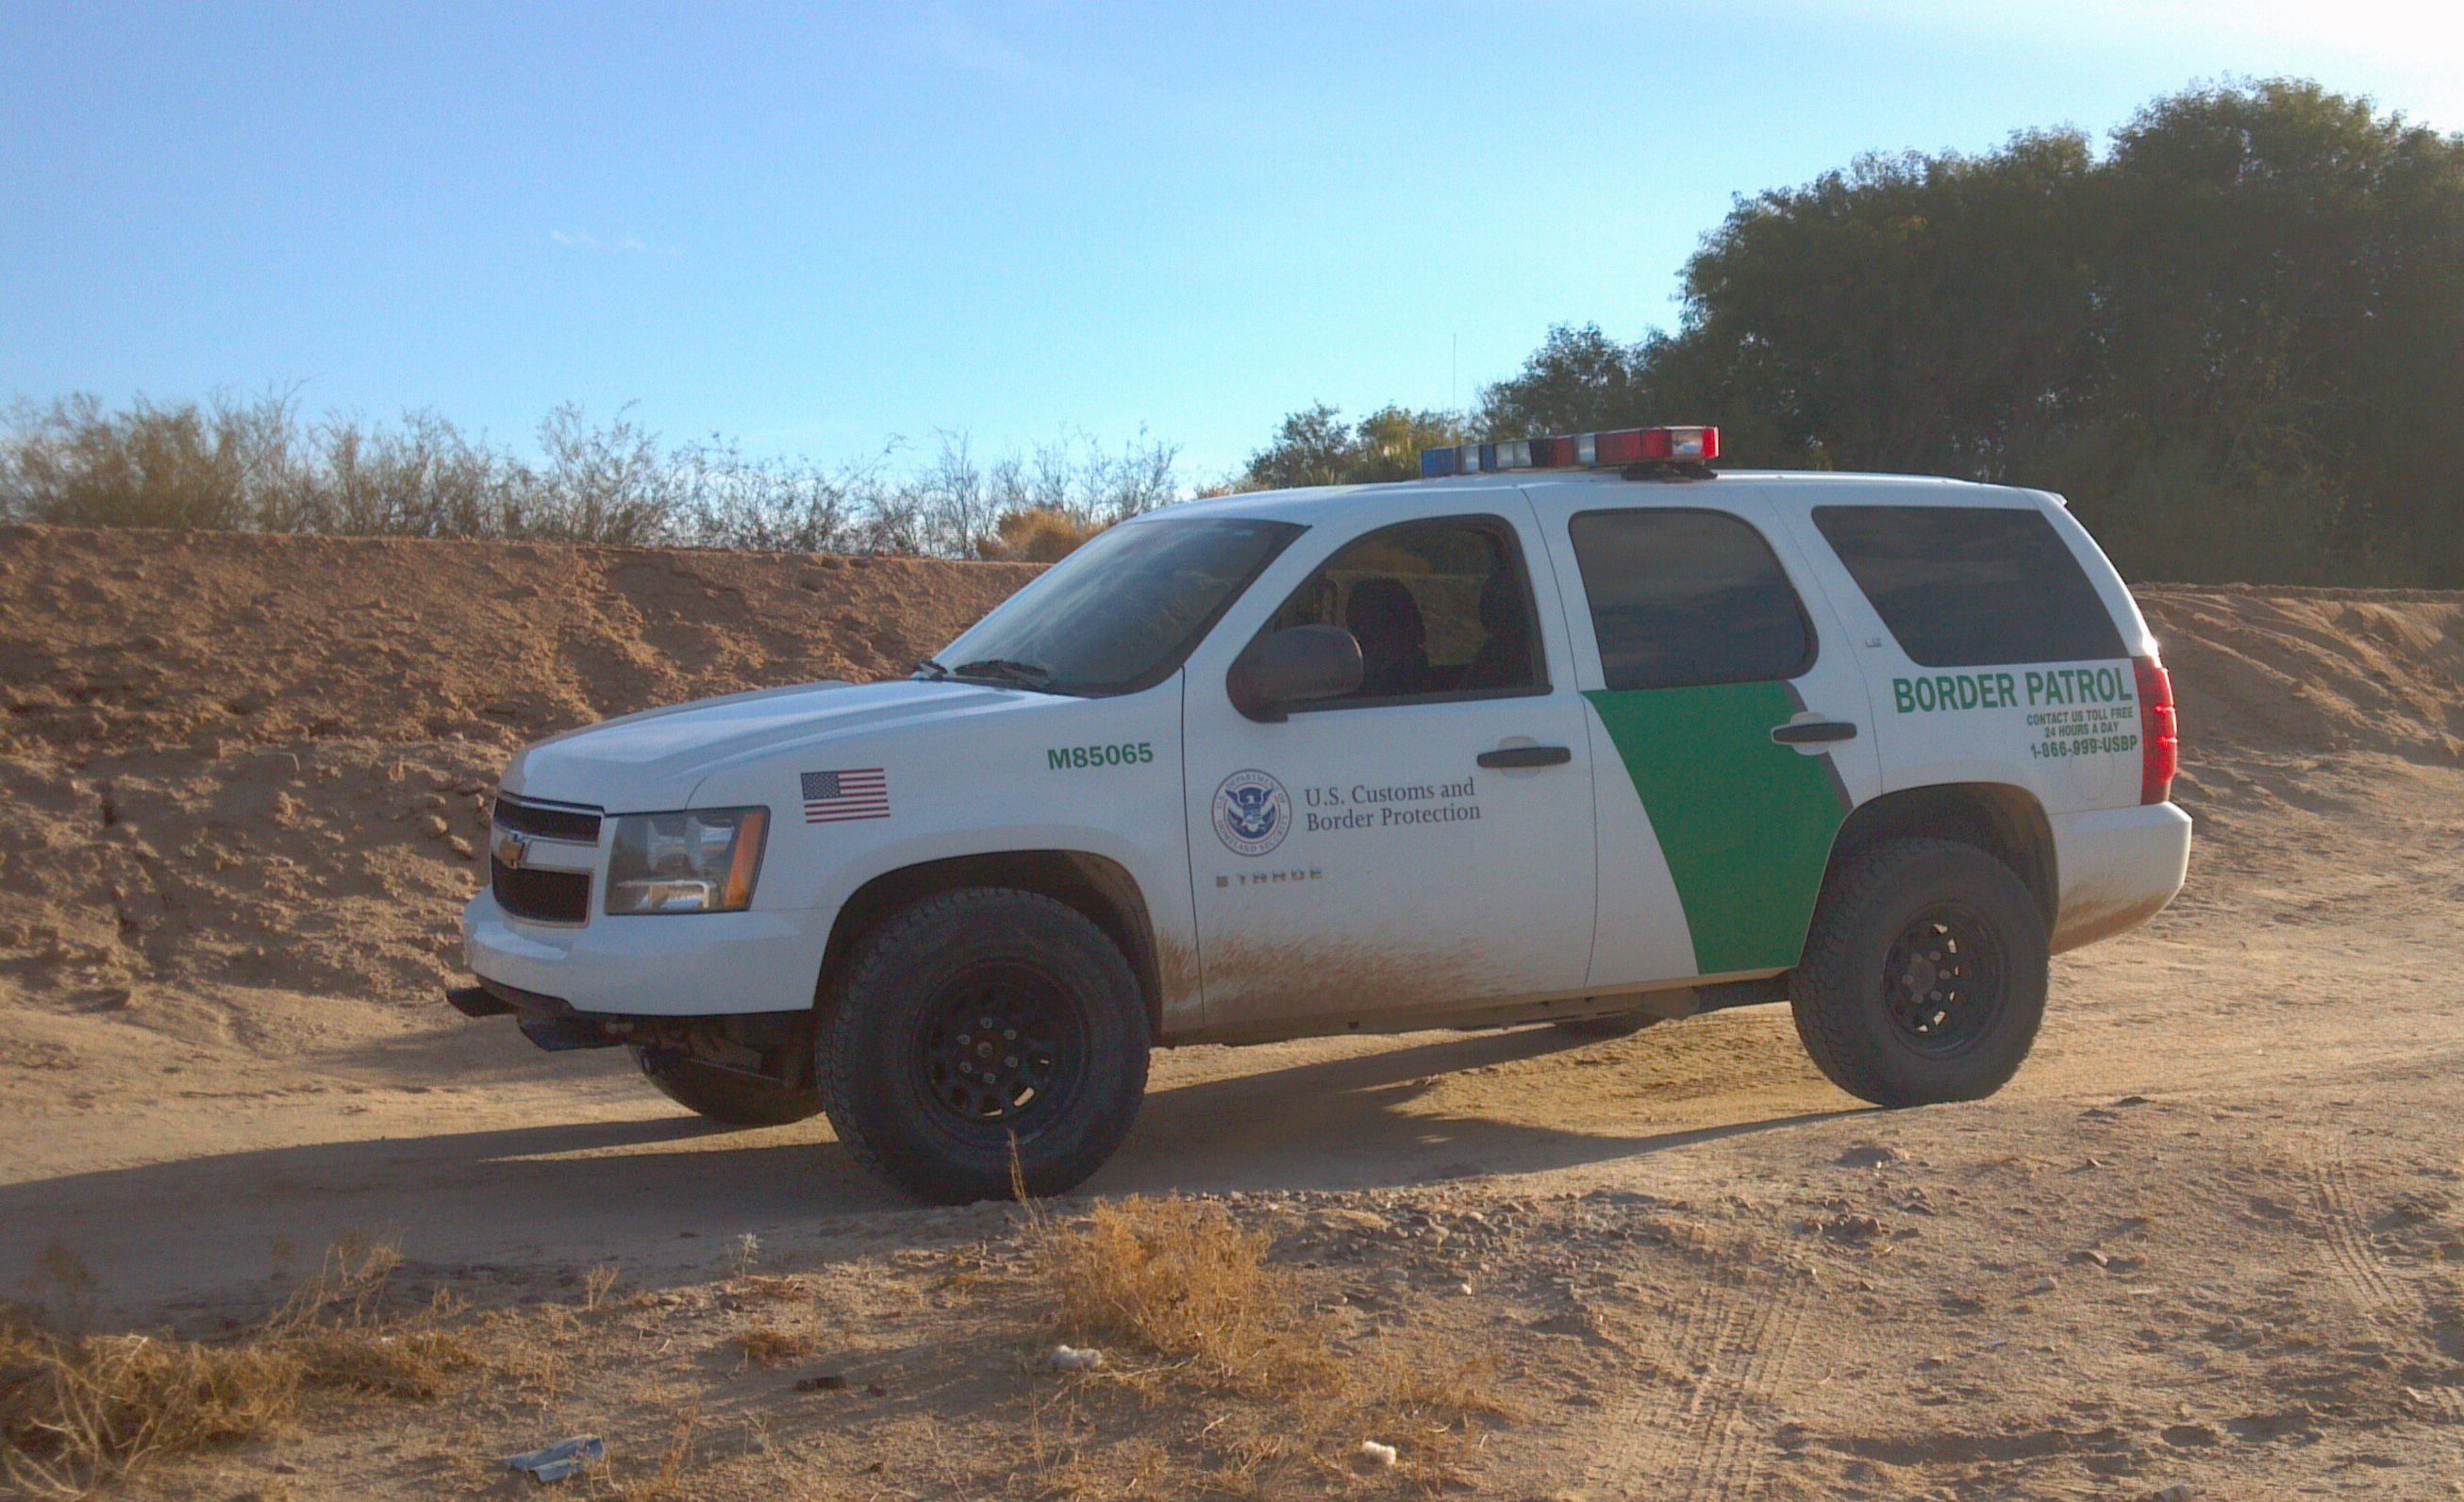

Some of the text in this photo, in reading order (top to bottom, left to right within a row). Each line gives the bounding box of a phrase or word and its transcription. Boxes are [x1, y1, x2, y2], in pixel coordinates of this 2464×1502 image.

[1892, 667, 2134, 714] BORDER PATROL
[2026, 707, 2133, 726] CONTACT US TOLL FREE
[2044, 721, 2120, 738] 24 HOURS A DAY
[1047, 742, 1154, 770] M85065
[2030, 735, 2139, 759] 1-866-999-USBP
[1305, 776, 1475, 808] U.S. Customs and
[1307, 803, 1481, 832] Border Protection
